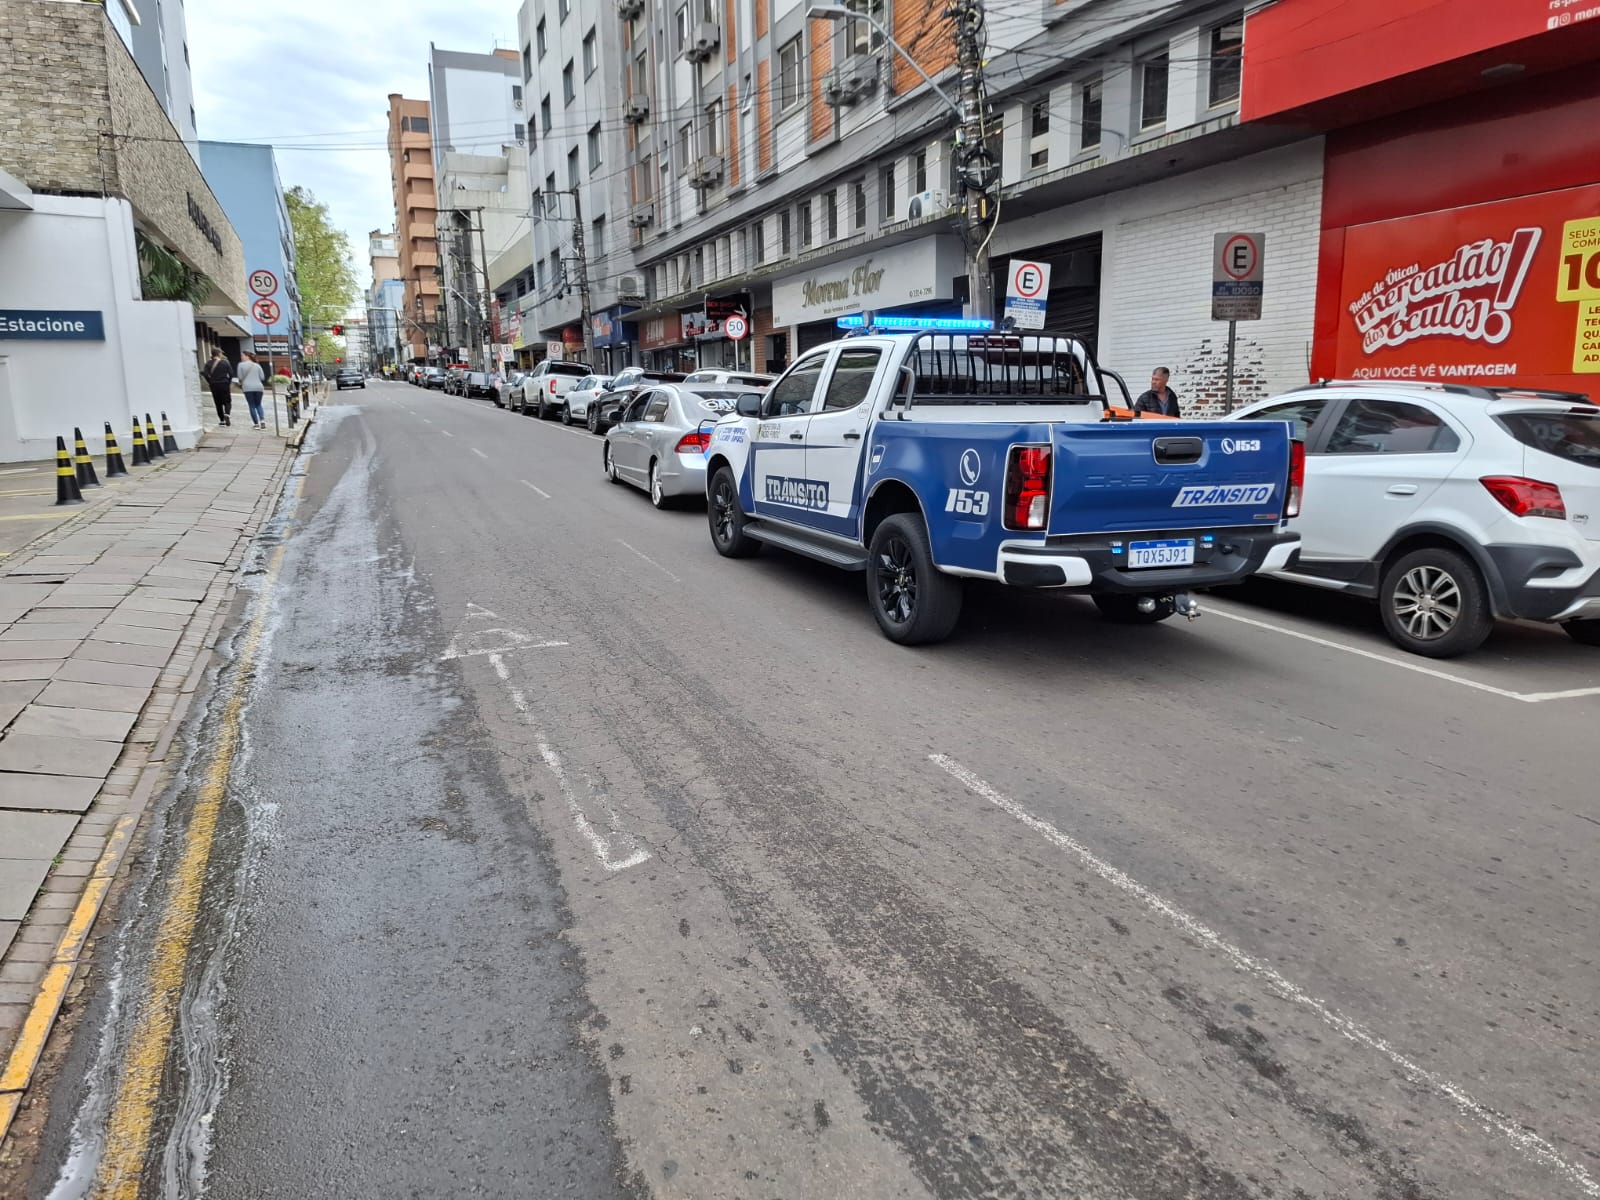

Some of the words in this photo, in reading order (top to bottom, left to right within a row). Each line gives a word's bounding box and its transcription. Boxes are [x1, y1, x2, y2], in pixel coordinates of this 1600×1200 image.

[1569, 229, 1596, 240] SEUS
[1233, 246, 1247, 269] E
[254, 275, 272, 288] 50
[802, 277, 849, 308] Morena
[851, 258, 885, 296] Flor
[1023, 271, 1035, 289] E
[1349, 291, 1372, 314] Rede
[1373, 281, 1385, 295] de
[0, 317, 85, 332] Estacione
[729, 321, 743, 331] 50
[1585, 318, 1600, 326] TE
[1364, 326, 1386, 348] dos
[1584, 329, 1600, 340] QU
[1583, 354, 1600, 362] AD
[1352, 367, 1381, 379] AQUI
[1384, 364, 1417, 378] VOCÊ
[1419, 363, 1436, 377] VÊ
[1438, 363, 1517, 377] VANTAGEM
[1235, 440, 1261, 451] 153
[766, 476, 827, 508] TRÂNSITO
[945, 488, 990, 516] 153
[1136, 548, 1187, 565] TQX5J91
